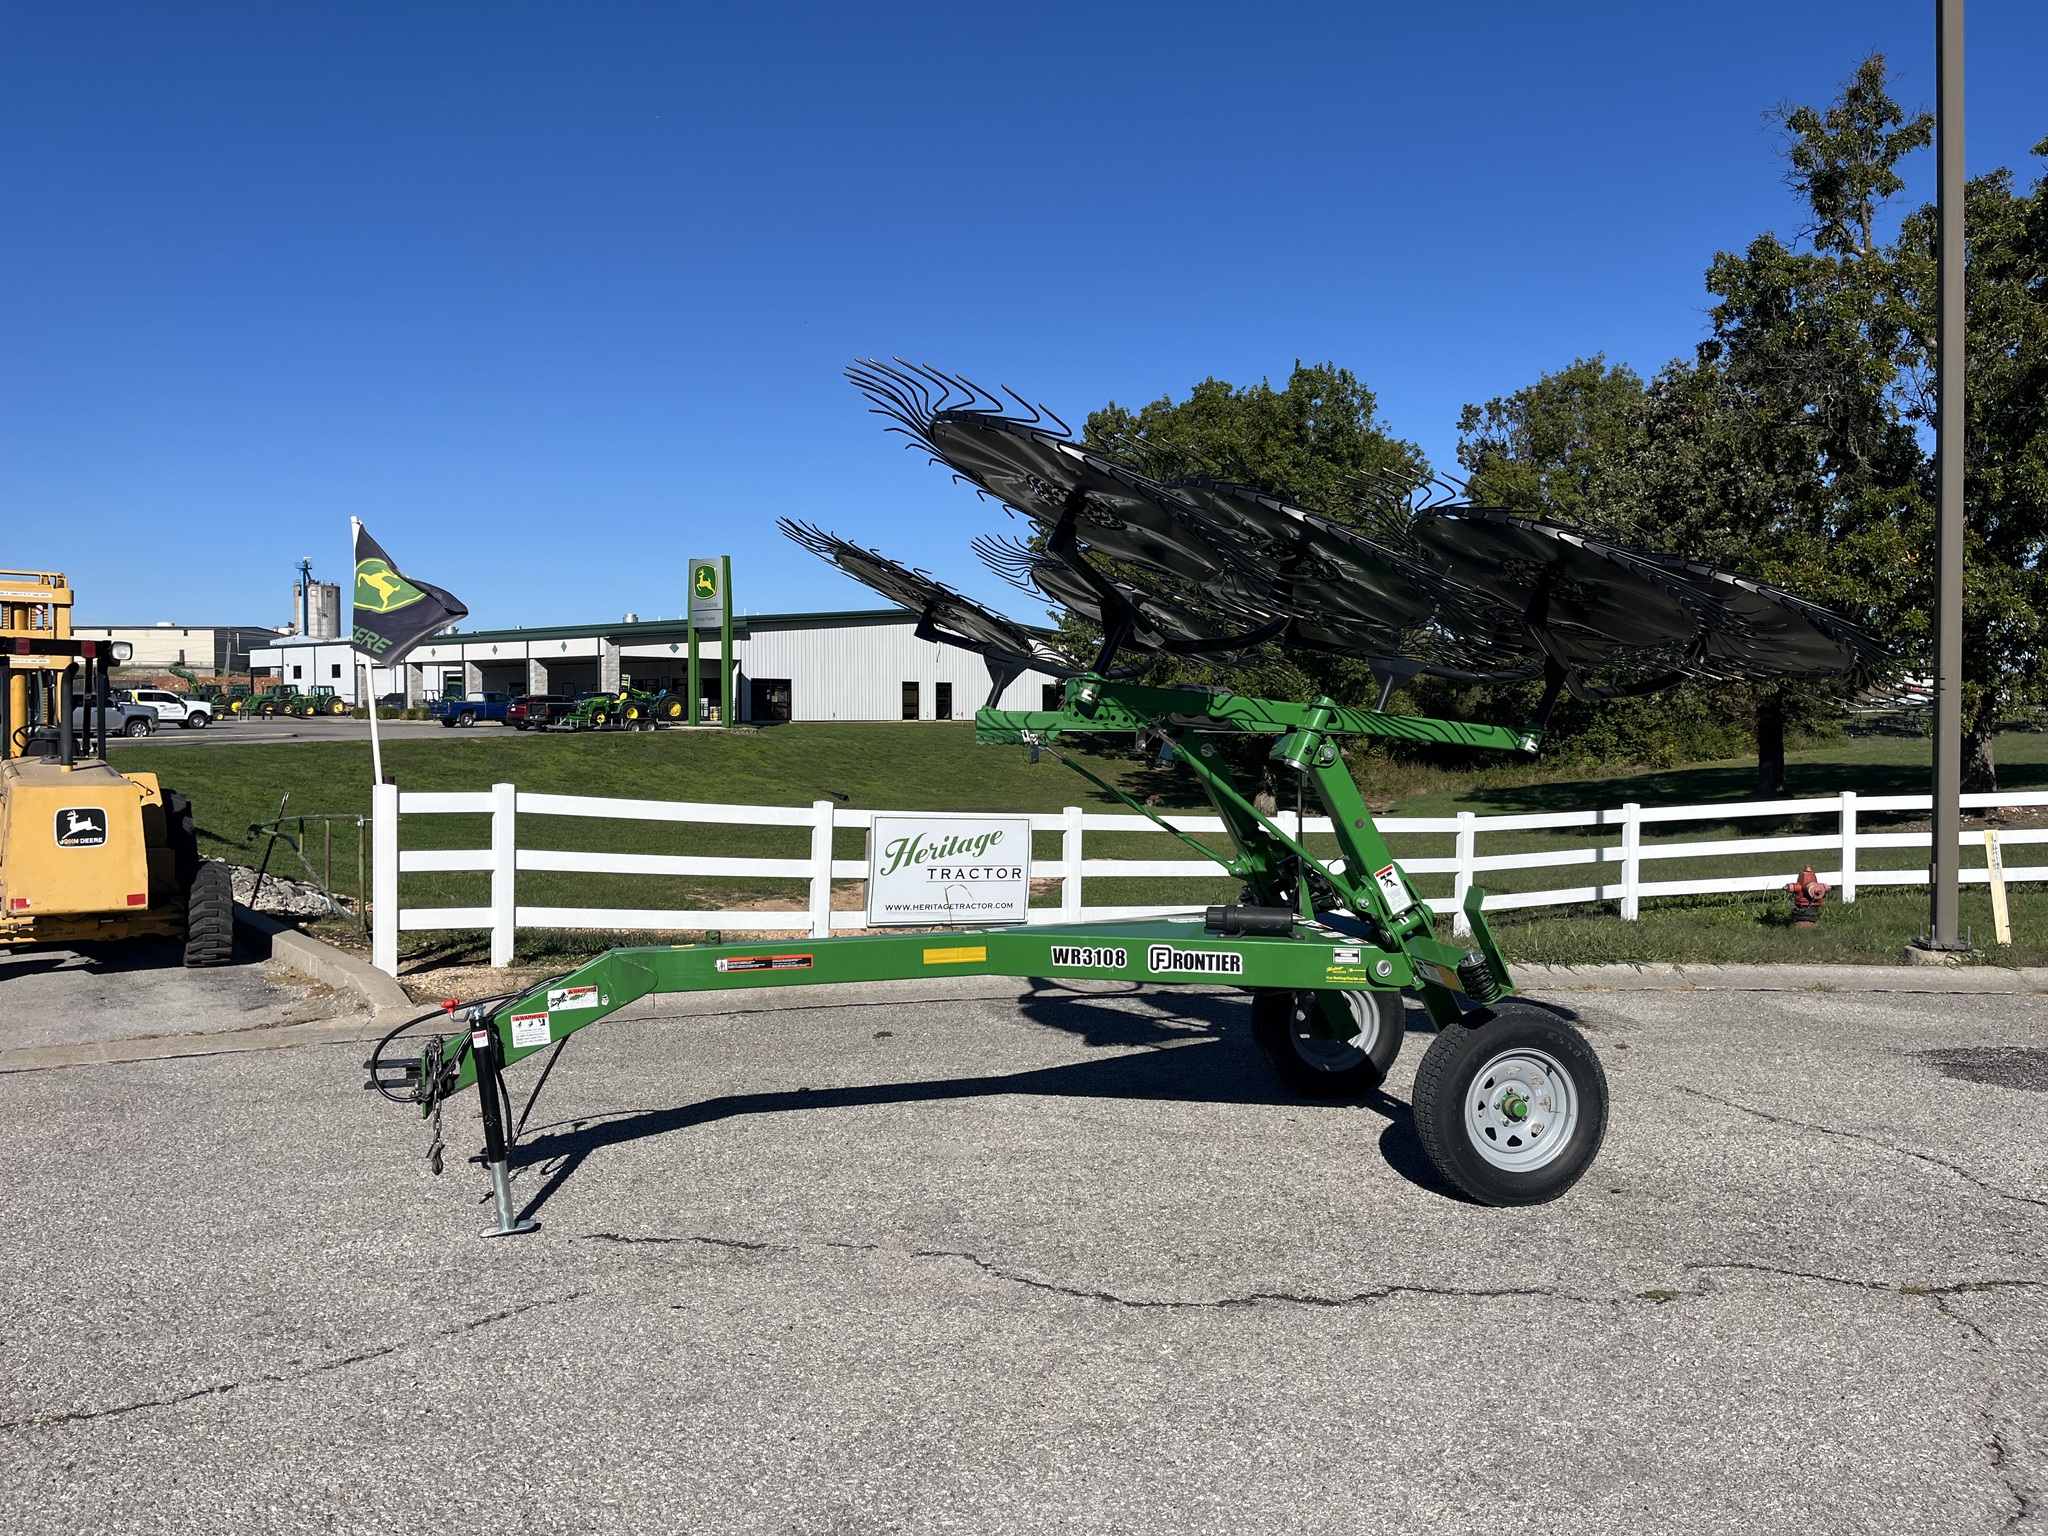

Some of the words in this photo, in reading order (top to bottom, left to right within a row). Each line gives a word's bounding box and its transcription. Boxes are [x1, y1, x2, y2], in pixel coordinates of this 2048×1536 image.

[353, 624, 393, 654] ERE
[880, 830, 1005, 876] Heritage
[927, 868, 1022, 880] TRACTOR
[885, 902, 1013, 911] WWW.HERITAGETRACTOR.COM
[1052, 947, 1126, 967] WR3108
[1150, 946, 1241, 972] FRONTIER
[520, 1013, 545, 1021] WARNING
